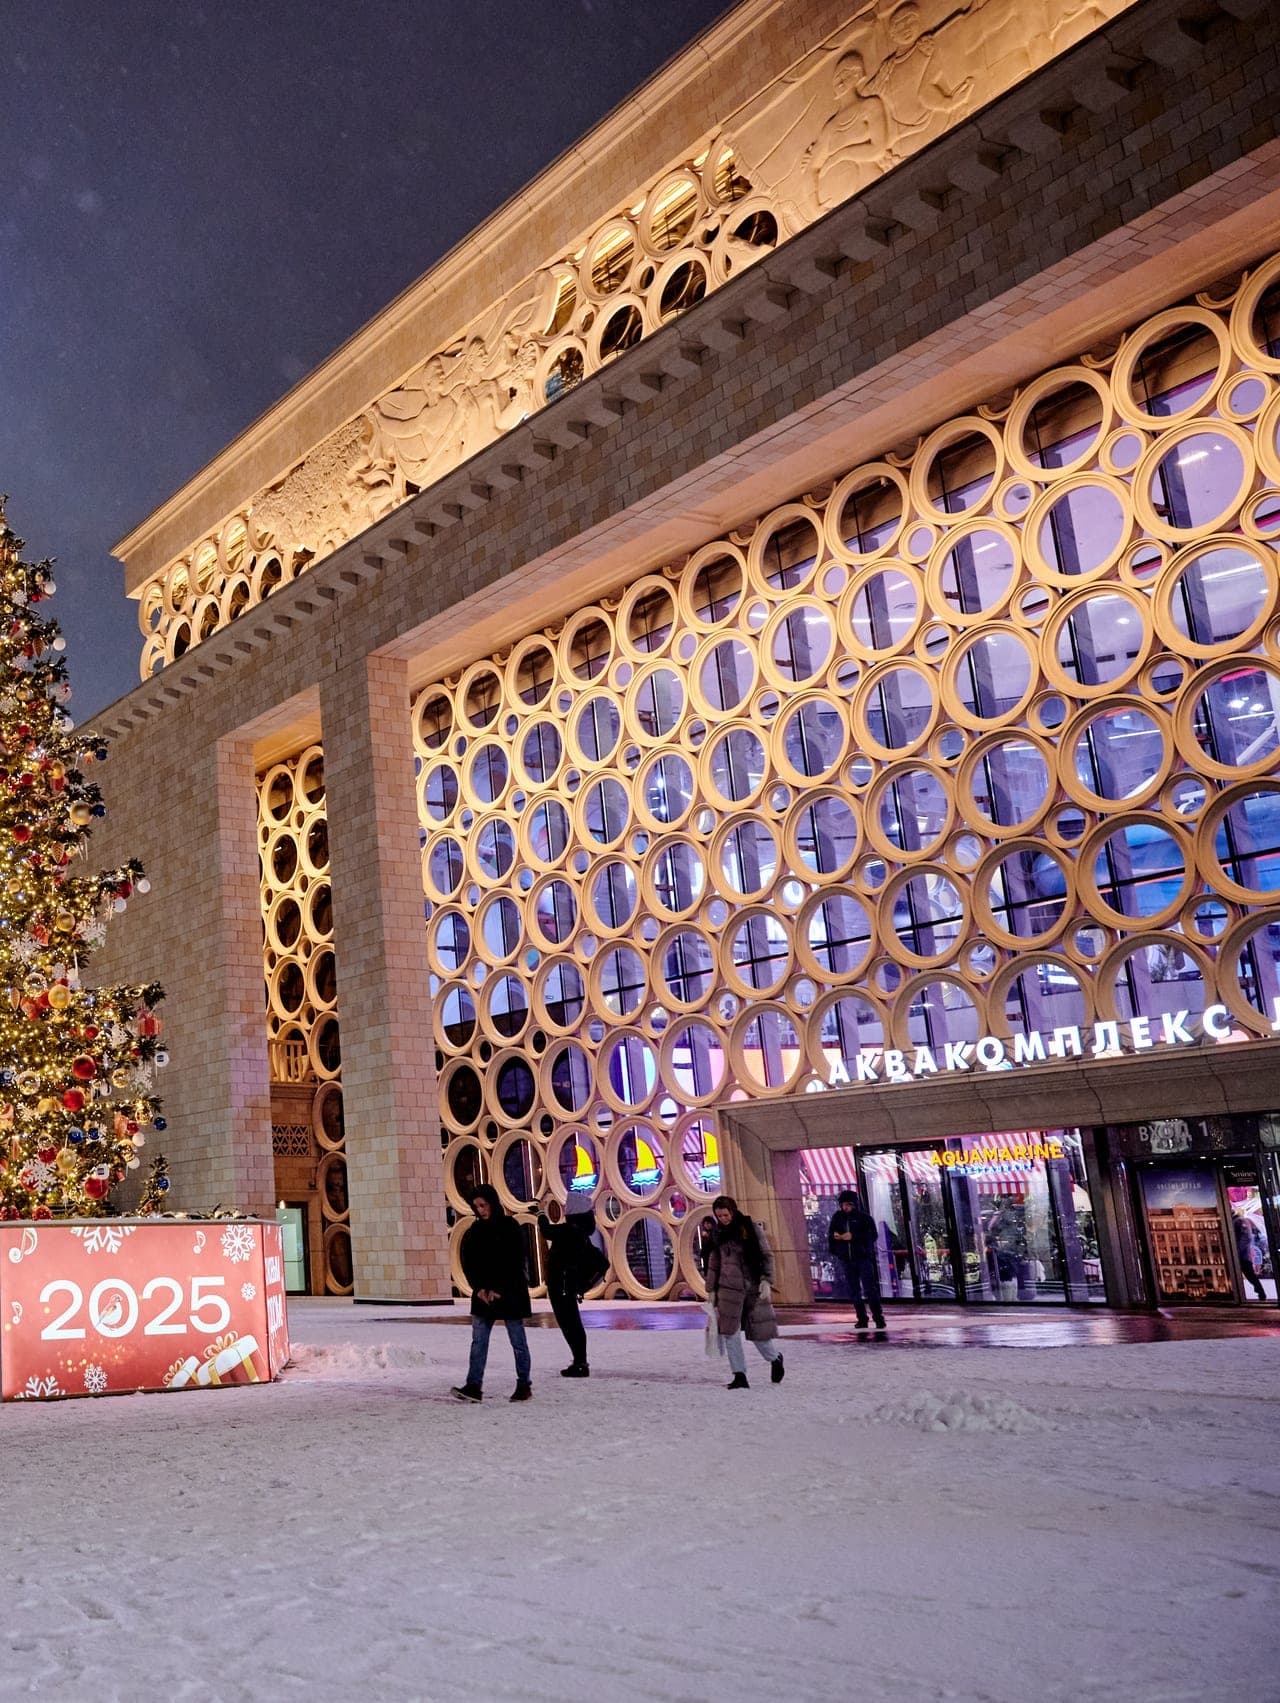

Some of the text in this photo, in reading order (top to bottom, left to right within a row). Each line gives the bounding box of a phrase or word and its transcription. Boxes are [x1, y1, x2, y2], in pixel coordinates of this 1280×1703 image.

[828, 1004, 1233, 1084] АКВАКОМПЛЕКС
[1198, 1120, 1209, 1137] 1
[930, 1142, 1066, 1168] AQUAMARINE
[39, 1275, 231, 1341] 2025
